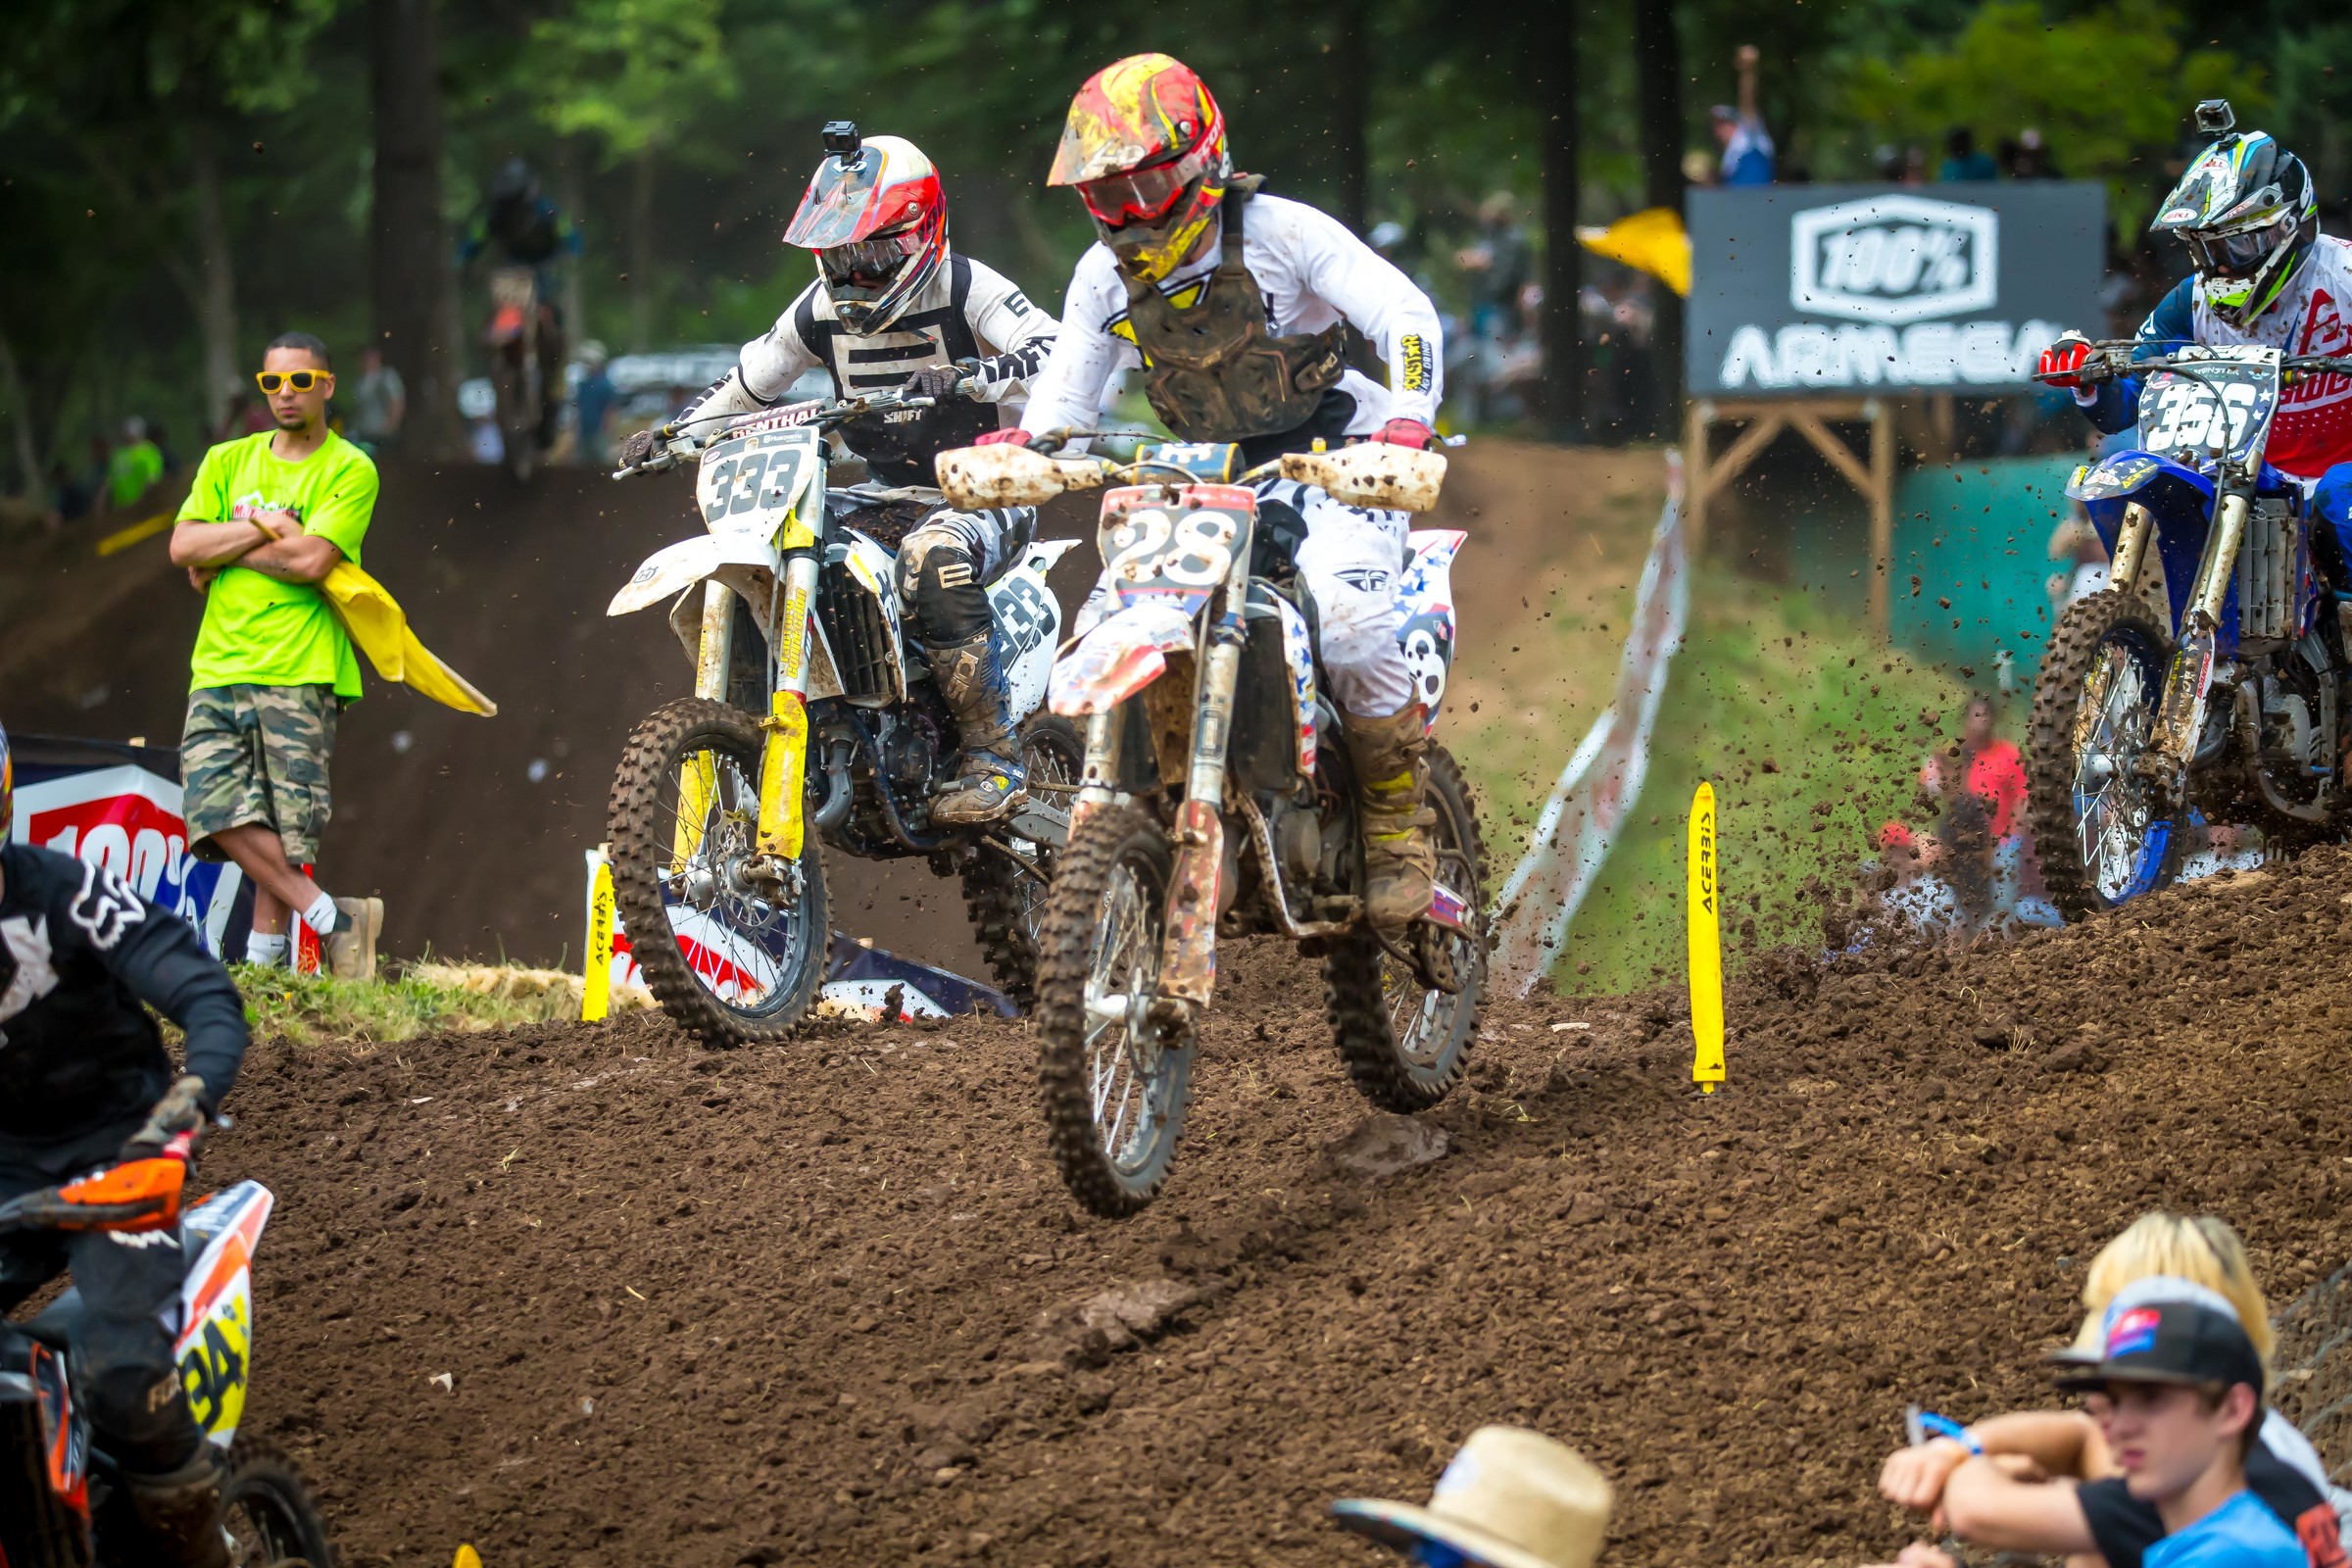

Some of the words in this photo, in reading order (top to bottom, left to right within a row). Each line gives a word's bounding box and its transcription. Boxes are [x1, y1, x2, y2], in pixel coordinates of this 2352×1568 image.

[1820, 225, 1968, 293] 100%
[883, 409, 923, 424] SHIFT
[2145, 381, 2257, 452] 356
[705, 449, 802, 524] 333
[1108, 509, 1238, 586] 28
[1700, 811, 1713, 915] ACERBIS
